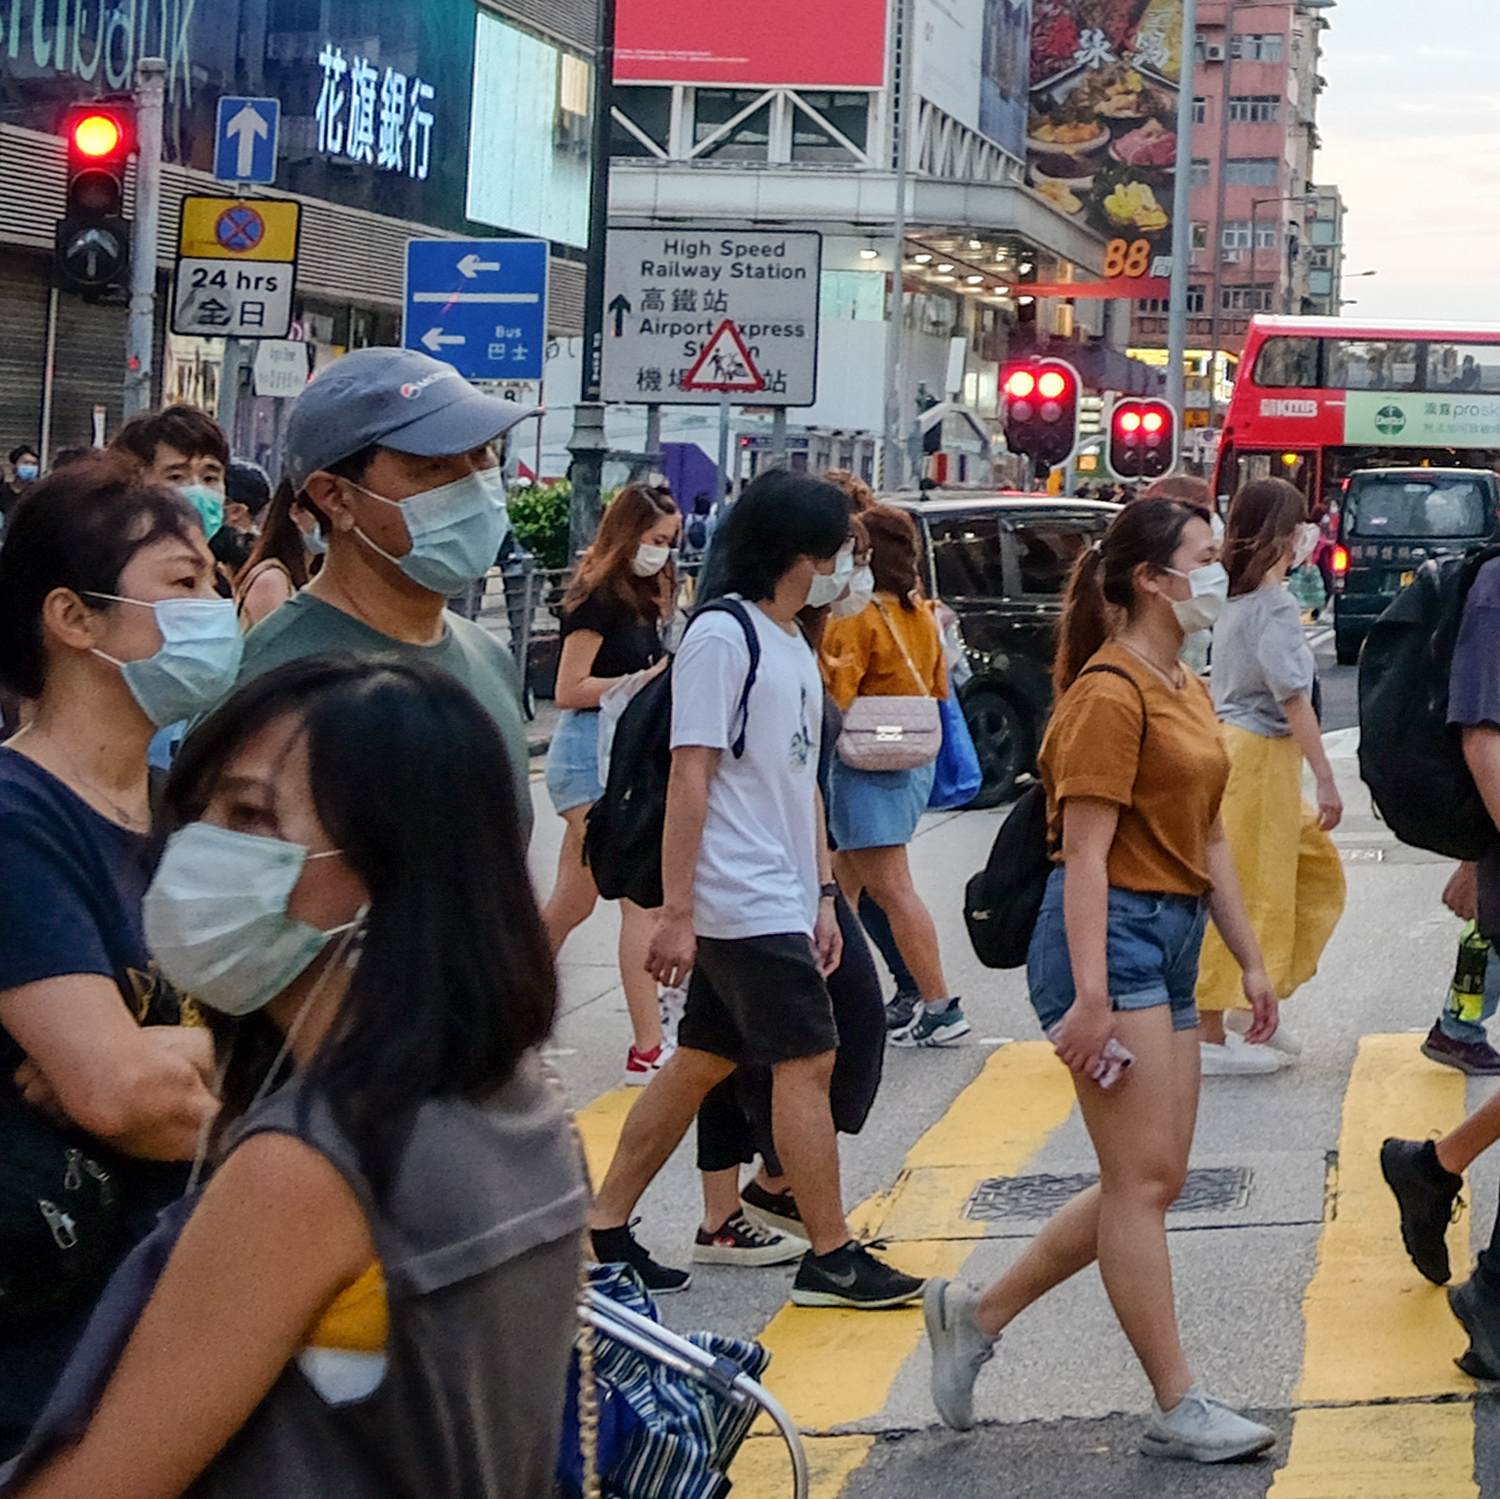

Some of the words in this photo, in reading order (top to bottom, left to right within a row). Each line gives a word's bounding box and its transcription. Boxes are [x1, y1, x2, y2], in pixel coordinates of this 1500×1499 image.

[316, 42, 435, 180] 花旗銀行
[663, 239, 712, 259] High
[719, 239, 786, 260] Speed
[1104, 237, 1151, 279] 88
[191, 267, 228, 289] 24
[236, 270, 278, 292] hrs
[641, 260, 723, 281] Railway
[729, 262, 807, 280] Station
[640, 287, 729, 313] 高鐵站
[197, 297, 265, 327] 全日
[495, 325, 523, 339] Bus
[639, 318, 714, 339] Airport
[737, 324, 805, 340] xpress
[487, 343, 529, 361] 巴士
